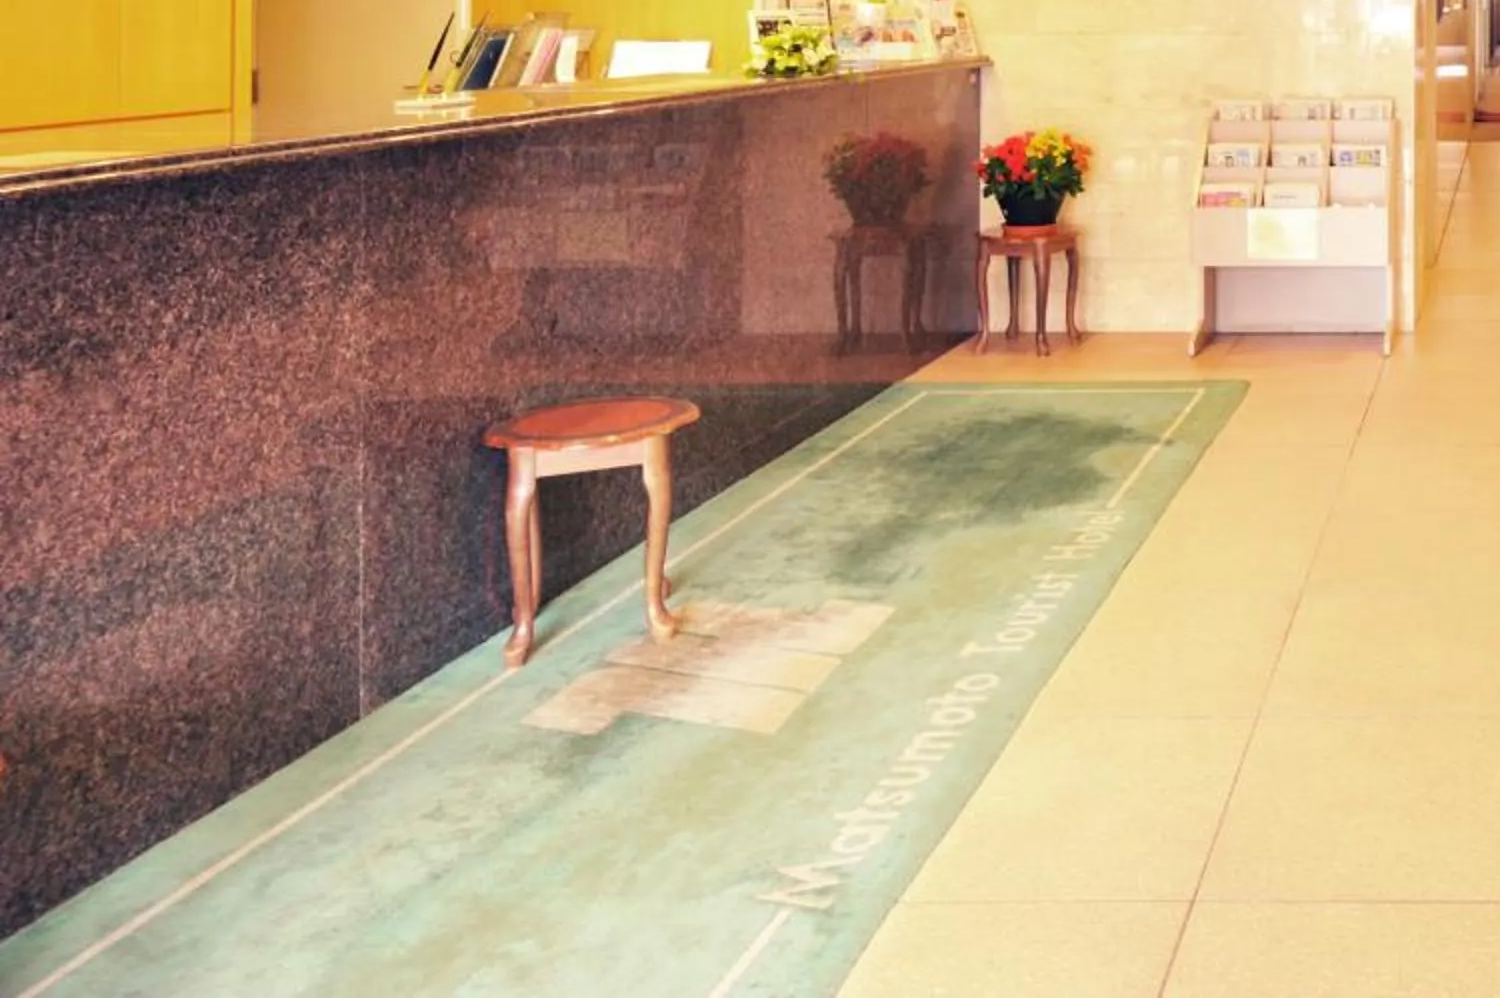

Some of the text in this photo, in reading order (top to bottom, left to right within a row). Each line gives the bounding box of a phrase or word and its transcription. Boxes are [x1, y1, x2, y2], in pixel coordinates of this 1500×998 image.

[755, 509, 1125, 911] Matsumoto Tourist Hotel
